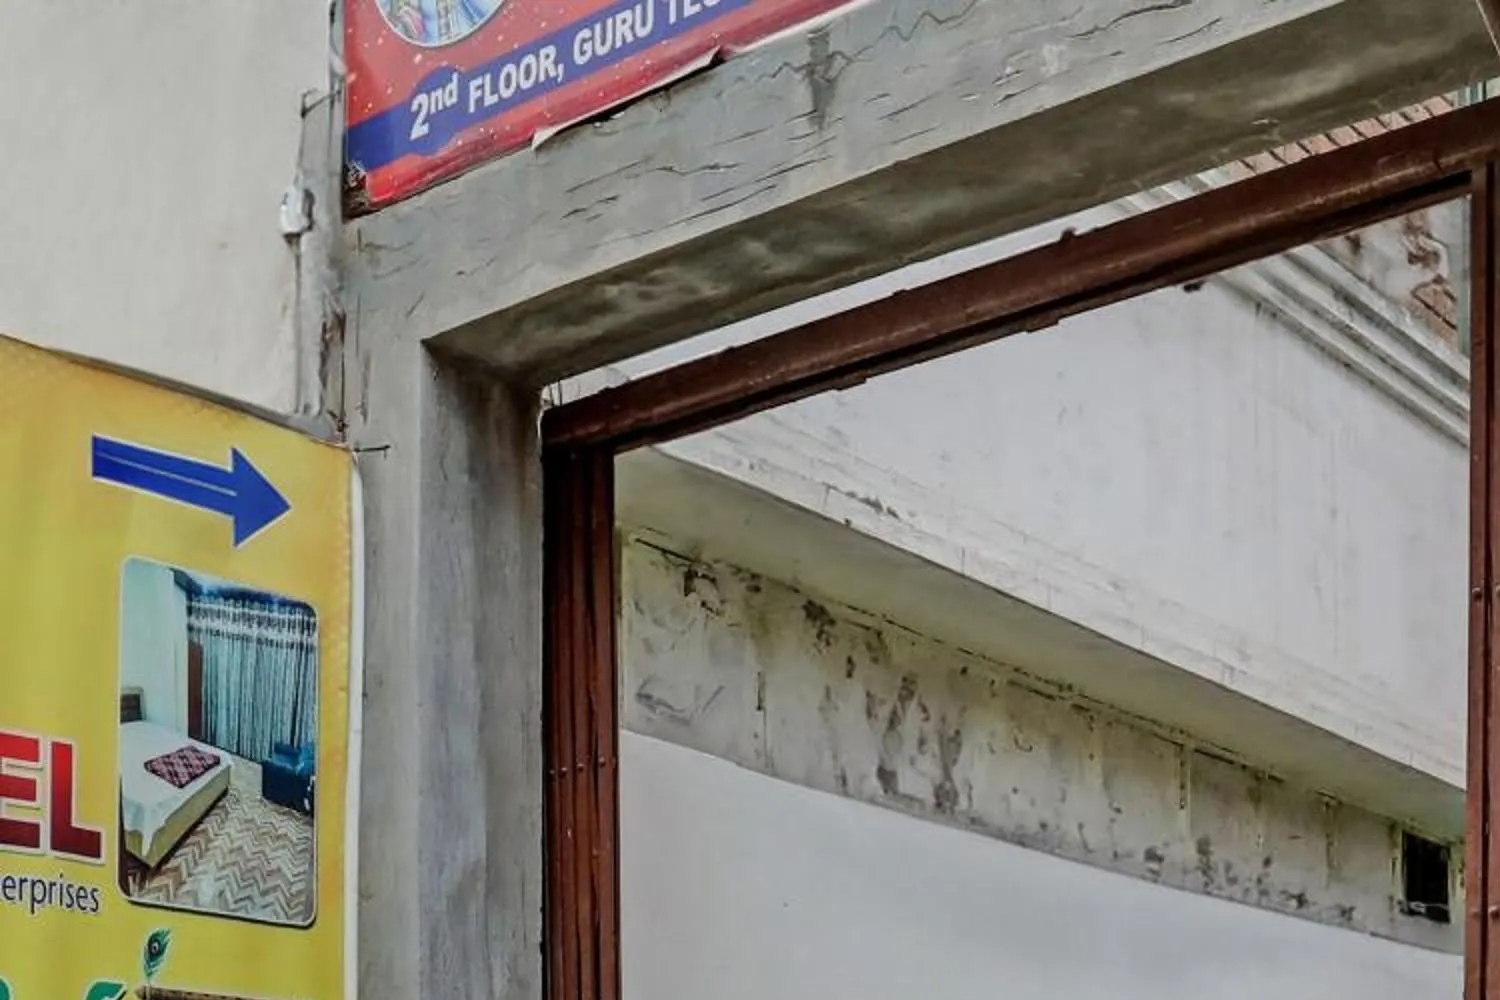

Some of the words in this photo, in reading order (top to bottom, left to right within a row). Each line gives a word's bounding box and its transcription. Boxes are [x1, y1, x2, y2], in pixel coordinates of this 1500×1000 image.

[409, 71, 459, 141] 2nd
[467, 44, 565, 114] FLOOR,
[572, 0, 655, 65] GURU
[1, 872, 101, 914] erprises
